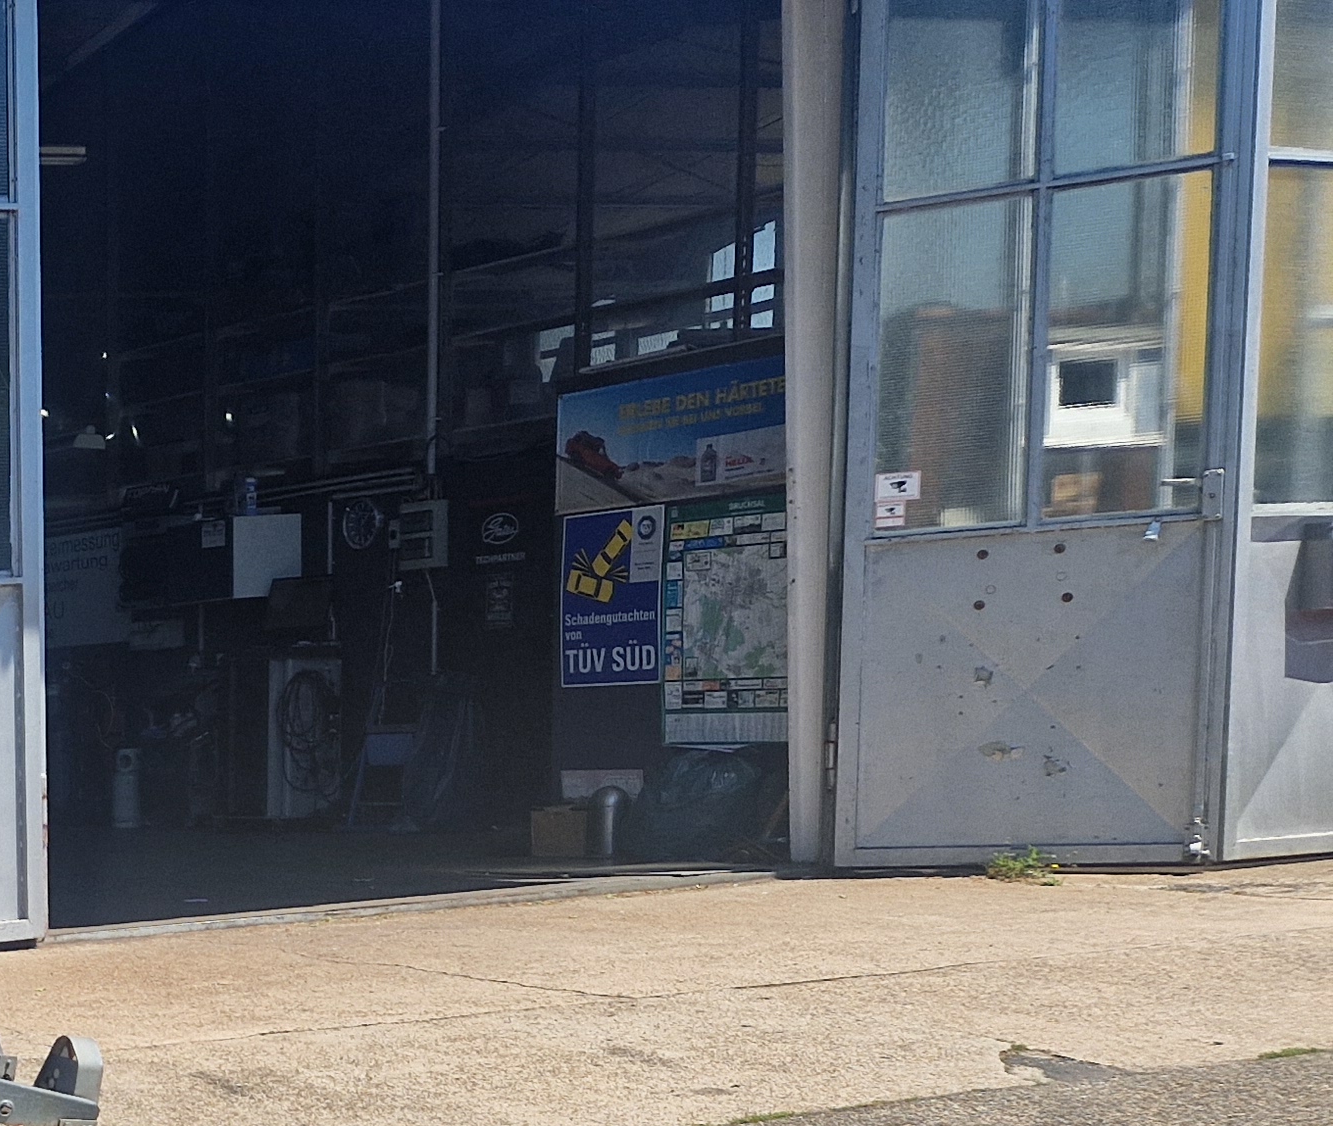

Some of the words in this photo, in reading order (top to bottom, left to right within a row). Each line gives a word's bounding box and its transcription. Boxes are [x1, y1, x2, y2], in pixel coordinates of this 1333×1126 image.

[676, 391, 710, 410] DEN
[48, 532, 120, 555] ermessung
[46, 555, 108, 573] wartung
[565, 608, 656, 627] Schadengutachten
[565, 630, 583, 641] von
[565, 643, 606, 674] TÜV
[612, 639, 656, 673] SÜD
